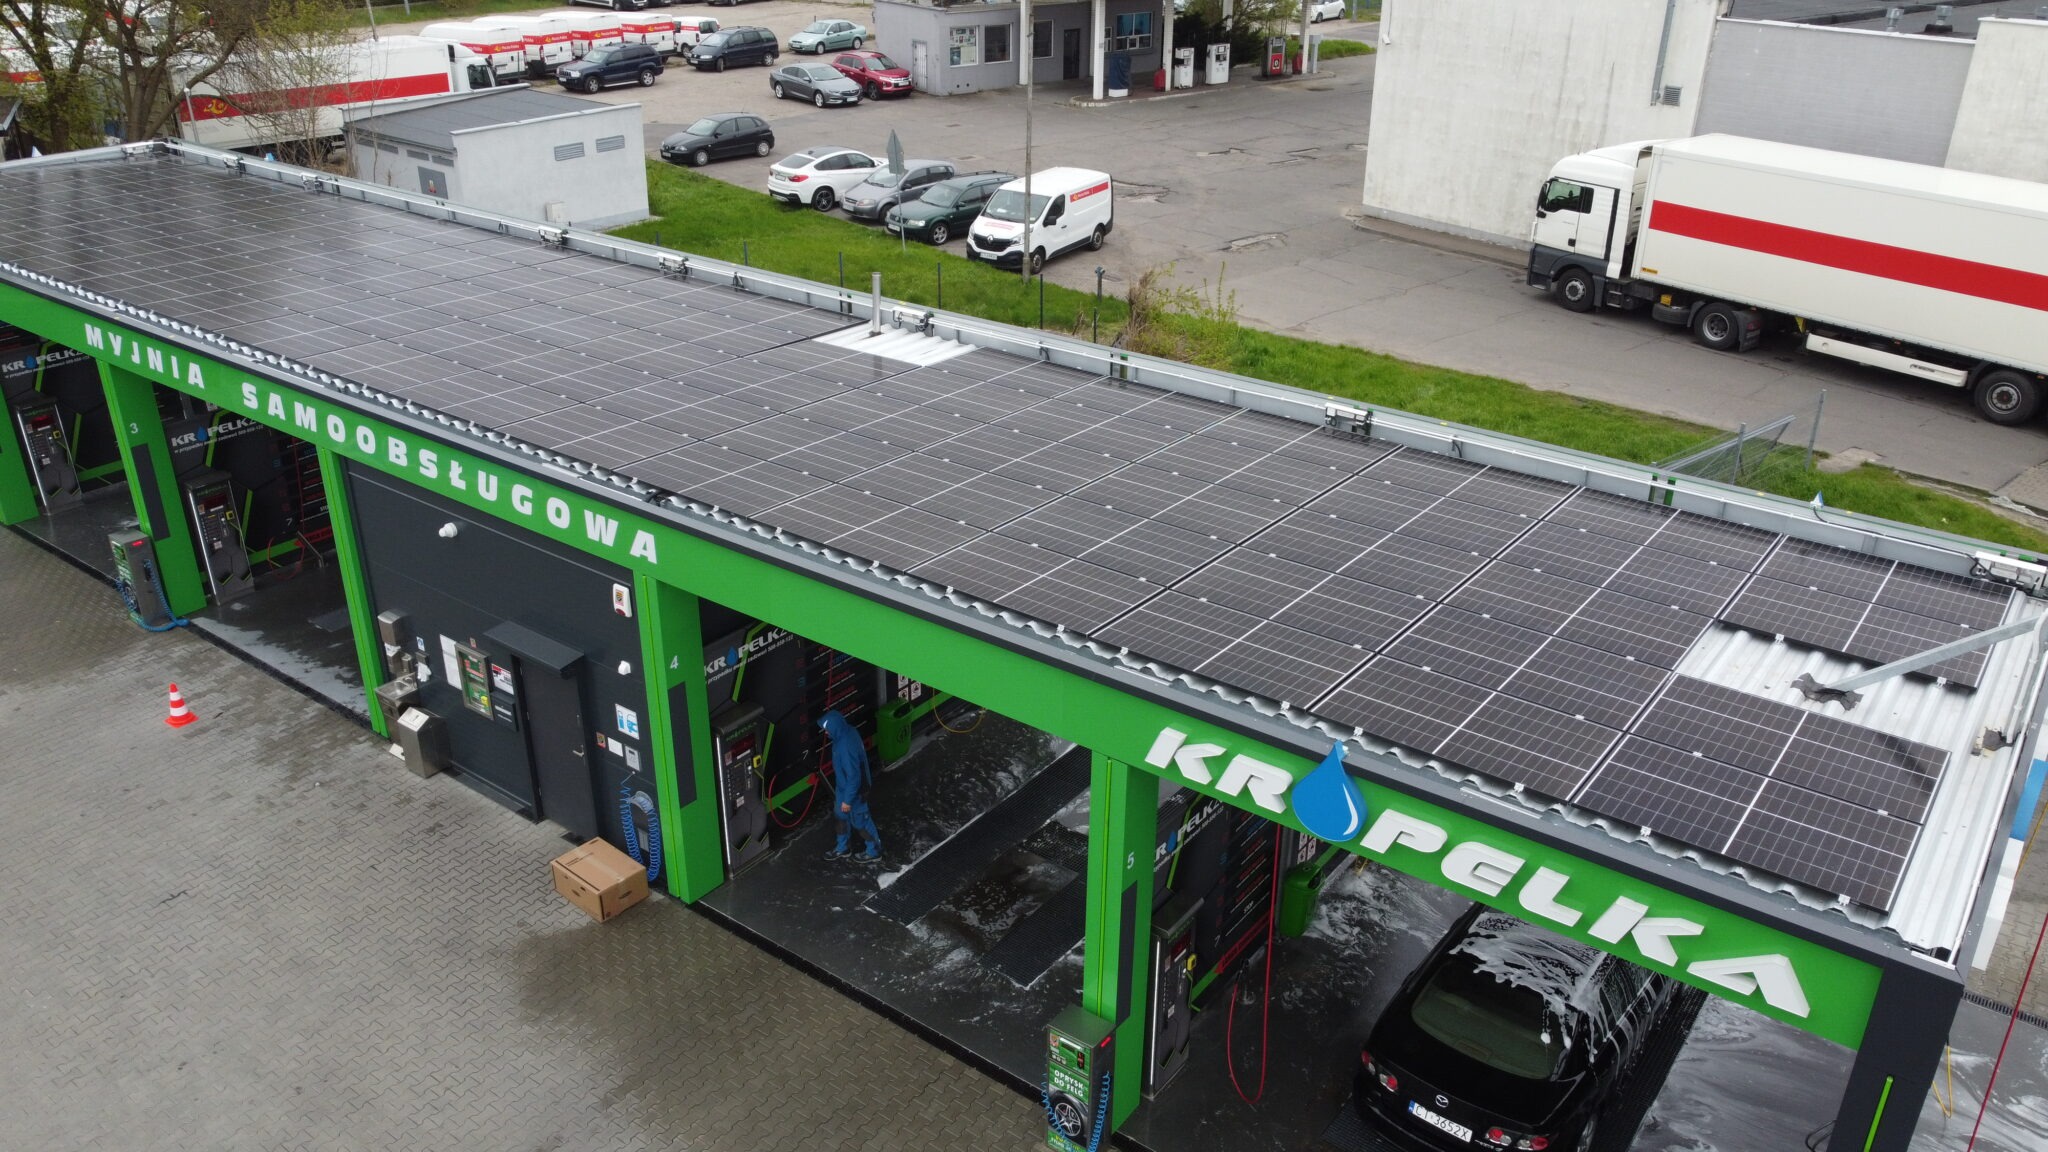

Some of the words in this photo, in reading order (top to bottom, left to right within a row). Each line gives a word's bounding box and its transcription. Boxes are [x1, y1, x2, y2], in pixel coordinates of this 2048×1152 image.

[130, 422, 138, 434] 3
[84, 323, 206, 389] MYJNIA
[241, 382, 658, 564] SAMOOBSŁUGOWA
[670, 655, 679, 669] 4
[1127, 851, 1135, 869] 5
[1054, 1069, 1084, 1090] OPRYSK
[1054, 1077, 1065, 1087] DO
[1066, 1083, 1083, 1097] FELG
